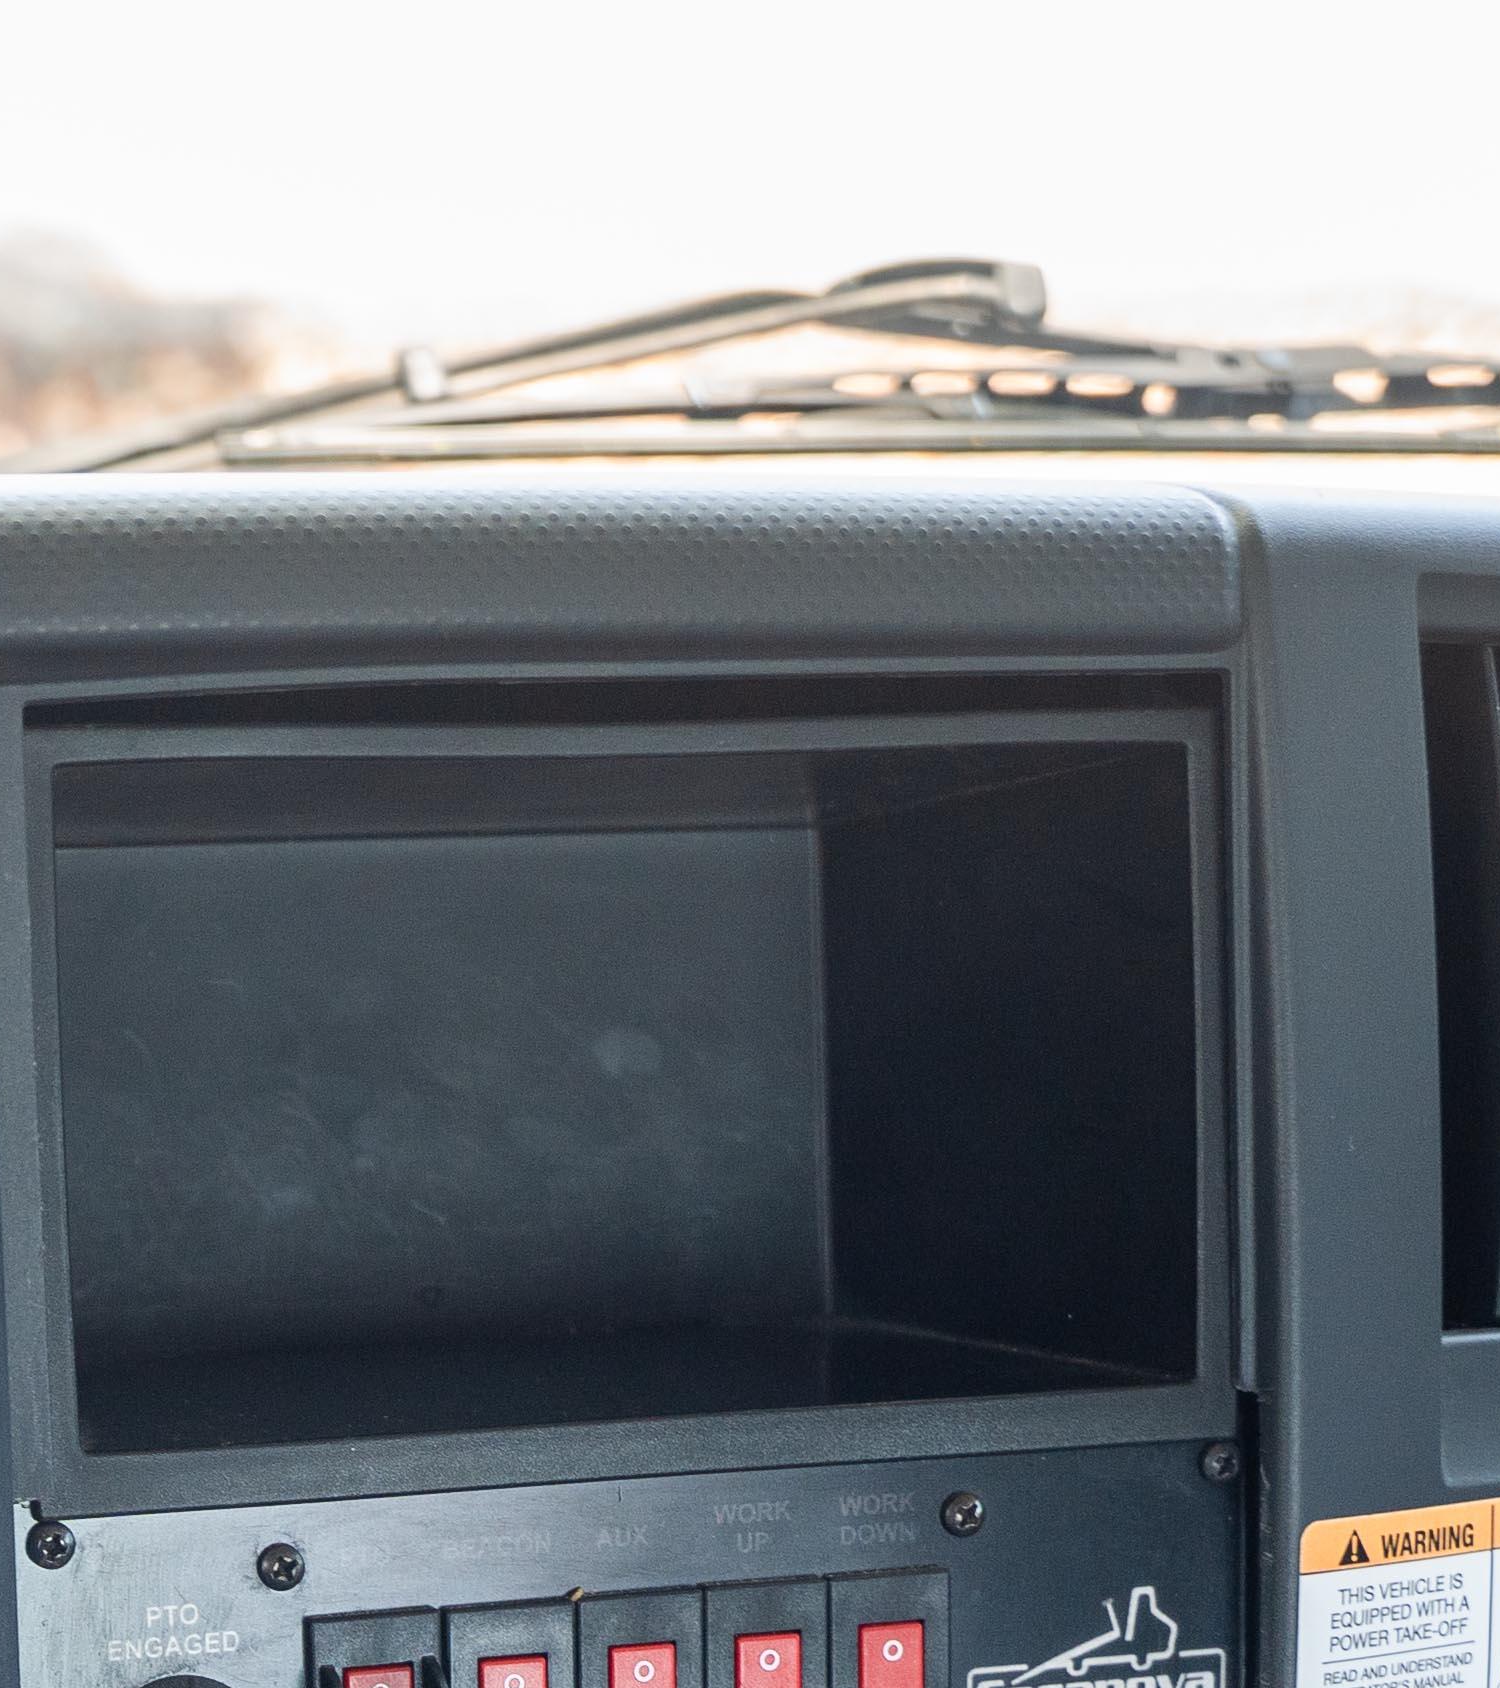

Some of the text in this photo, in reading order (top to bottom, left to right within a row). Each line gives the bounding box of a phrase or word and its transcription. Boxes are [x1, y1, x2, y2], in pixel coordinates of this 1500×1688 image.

[714, 1501, 792, 1525] WORK
[839, 1491, 916, 1517] WORK
[598, 1525, 649, 1549] AUX
[737, 1532, 770, 1554] UP
[840, 1523, 917, 1546] DOWN
[1381, 1524, 1474, 1558] WARNING
[1338, 1573, 1463, 1605] THIS VEHICLE IS
[146, 1603, 200, 1628] PTO
[1331, 1595, 1469, 1629] EQUIPPED WITH A
[107, 1630, 240, 1662] ENGAGED
[1330, 1618, 1468, 1652] POWER TAKE-OFF
[1323, 1652, 1472, 1685] READ AND UNDERSTAND
